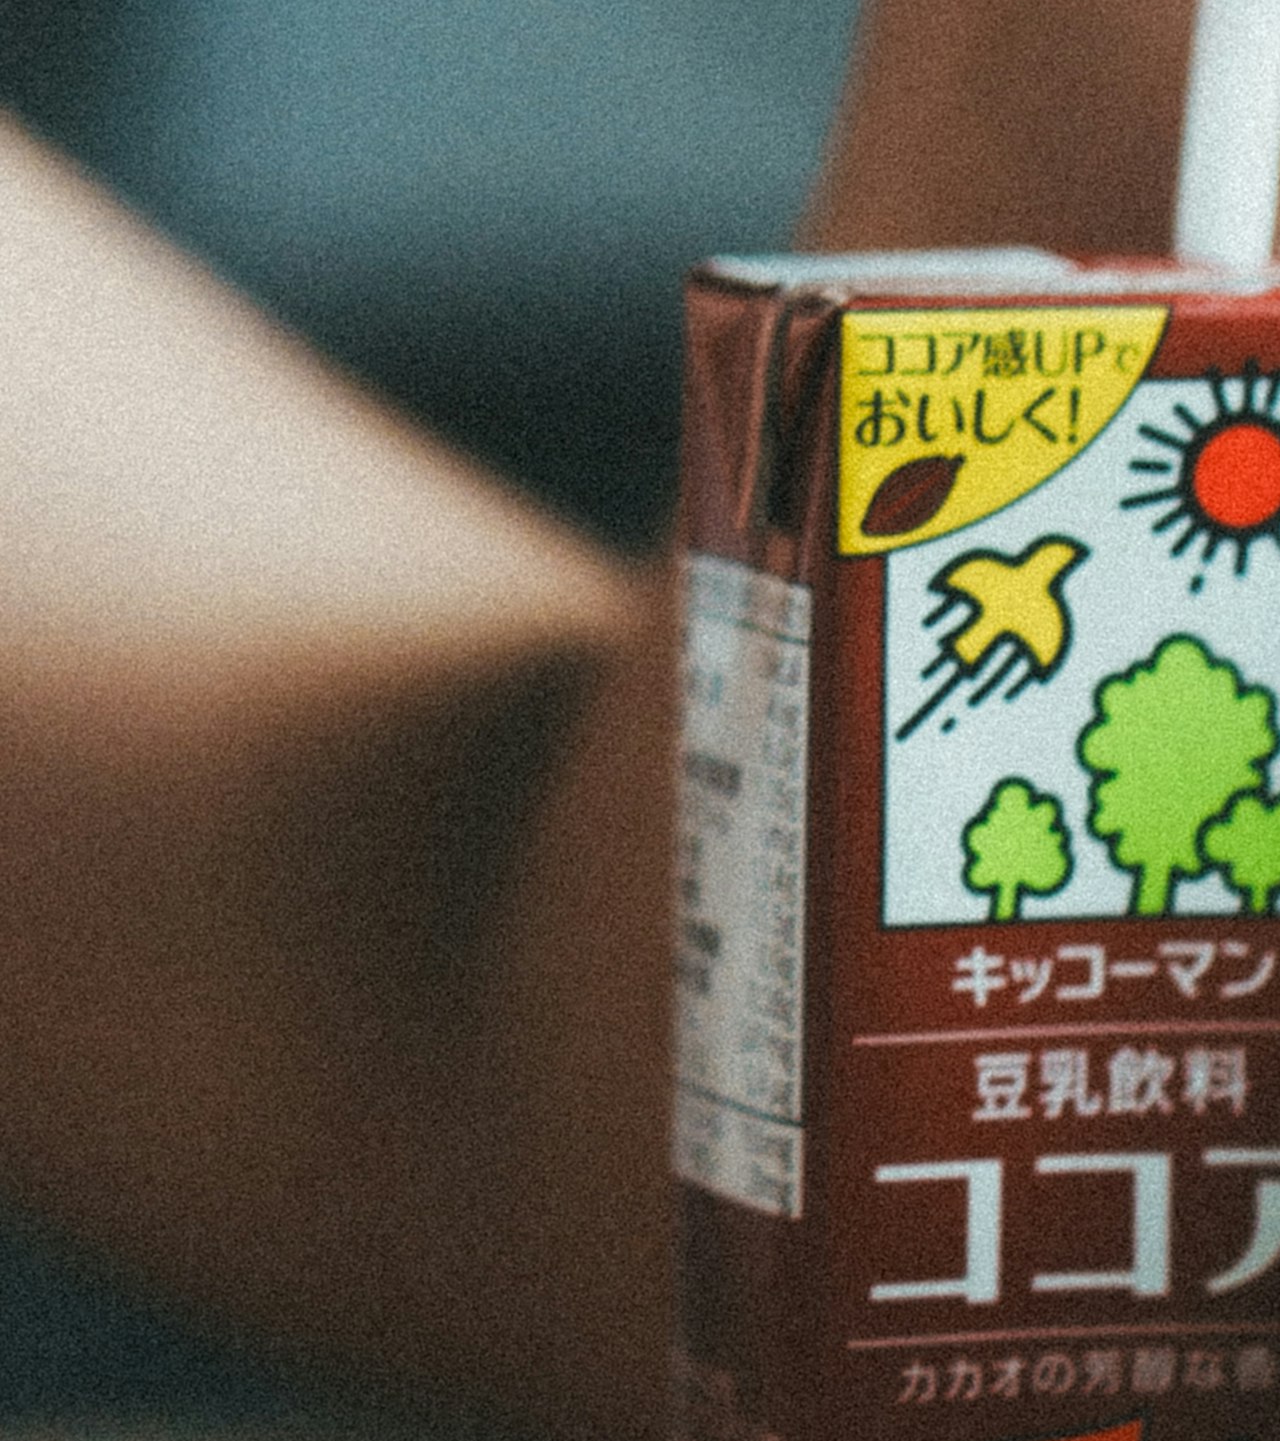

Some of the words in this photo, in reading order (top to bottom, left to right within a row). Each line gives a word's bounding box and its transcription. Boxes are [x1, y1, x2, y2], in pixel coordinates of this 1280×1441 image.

[854, 387, 1081, 448] おいしく!
[952, 940, 1276, 1007] キッコーマン
[972, 1046, 1248, 1122] 豆乳飲料
